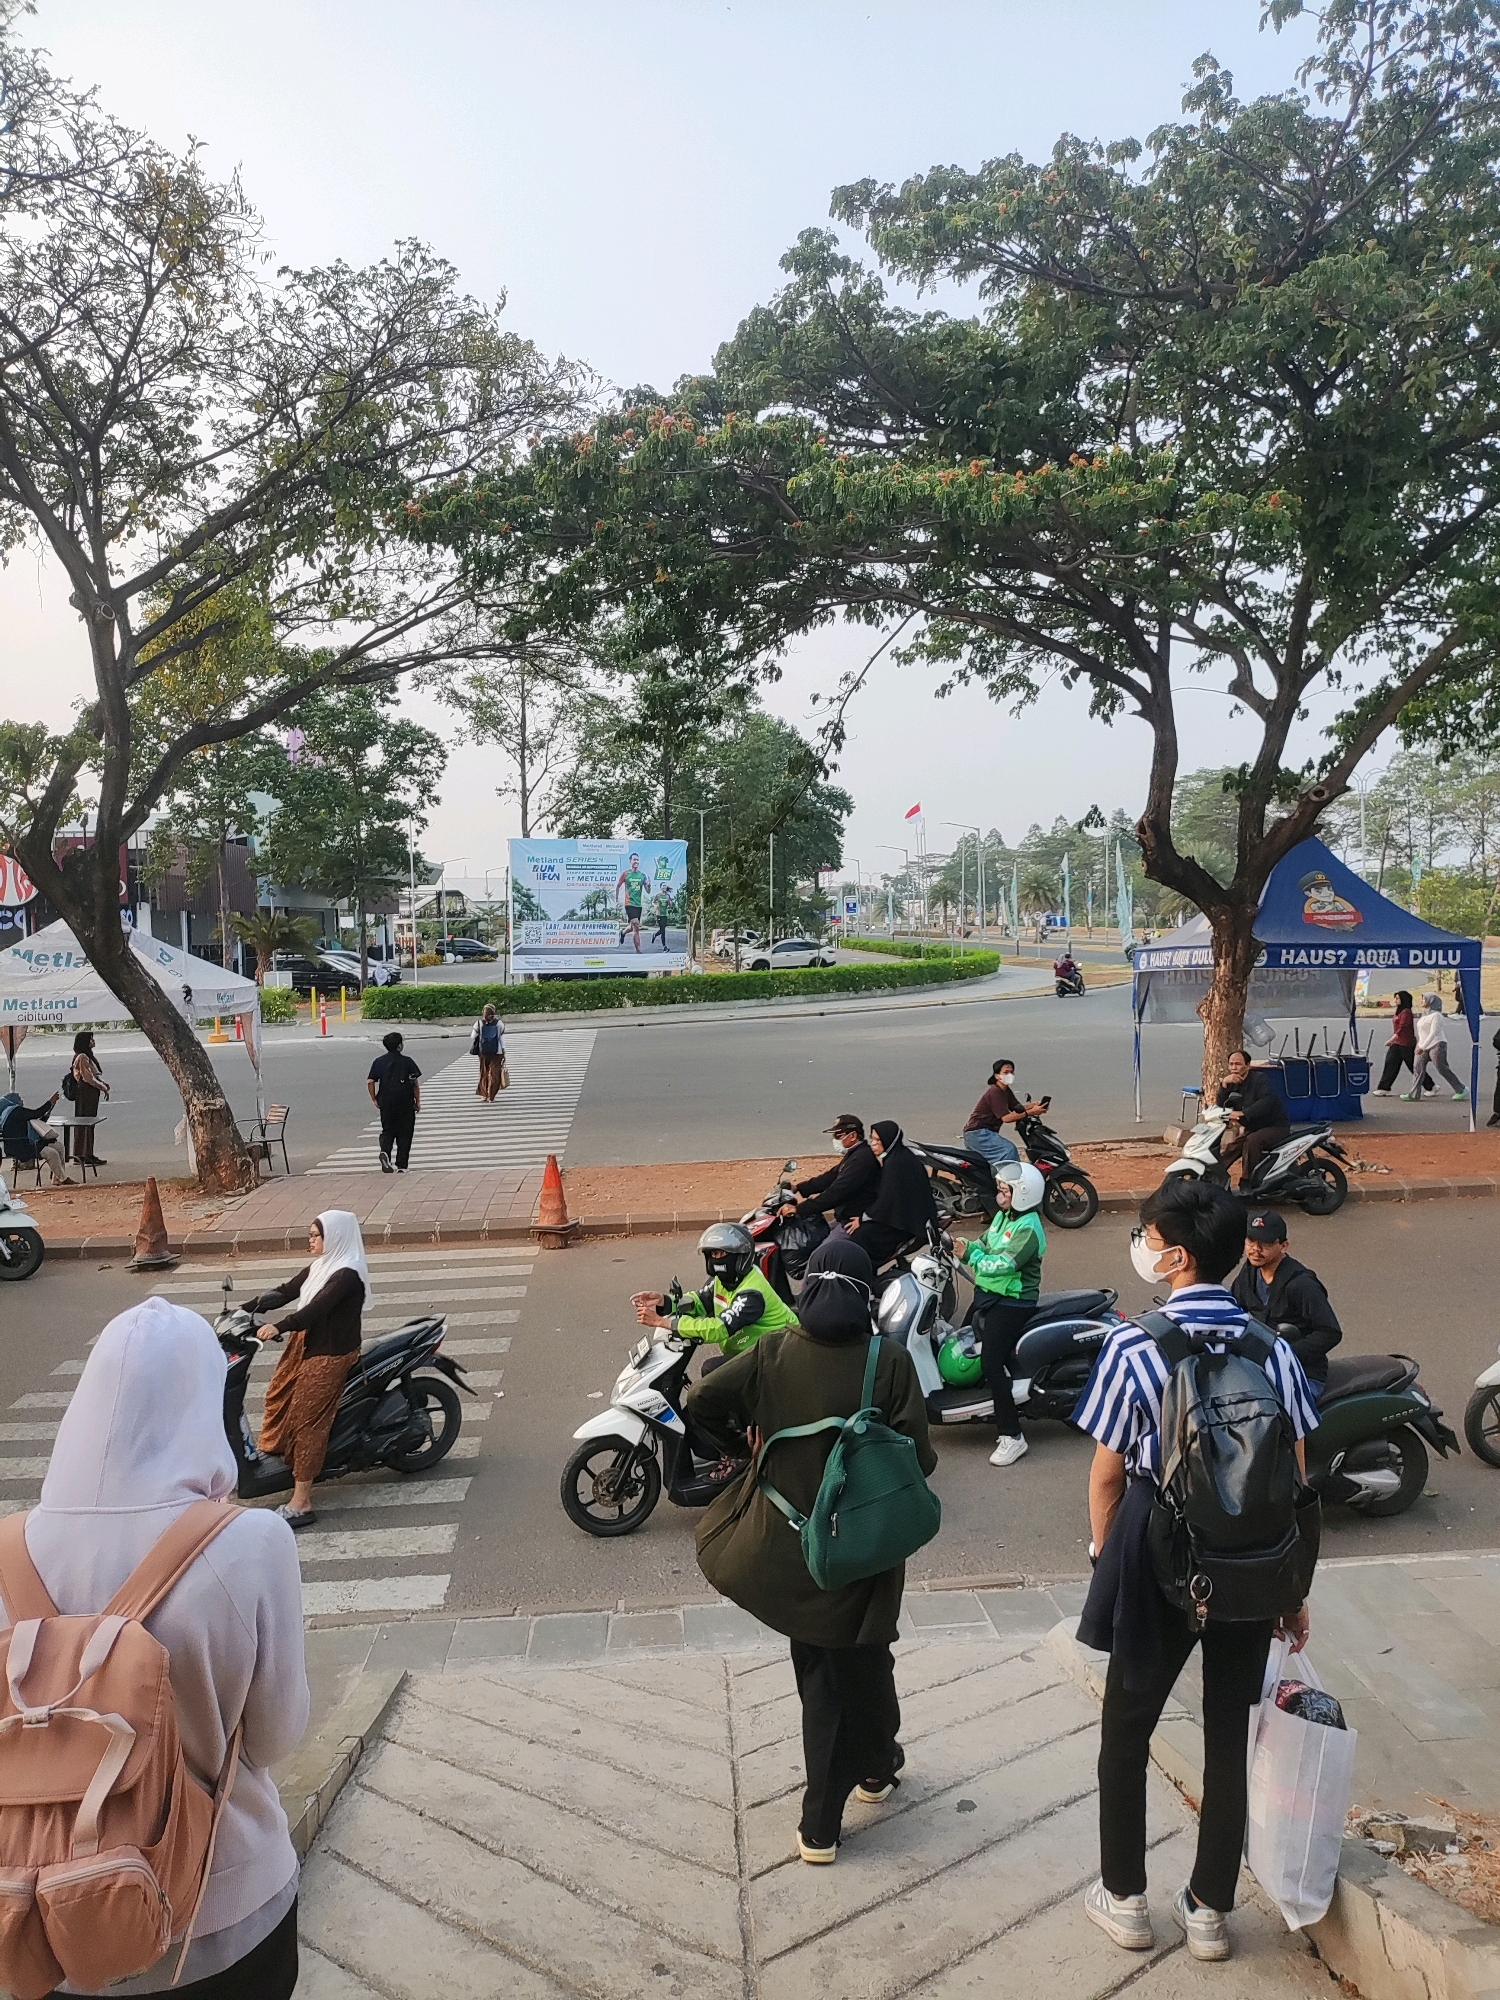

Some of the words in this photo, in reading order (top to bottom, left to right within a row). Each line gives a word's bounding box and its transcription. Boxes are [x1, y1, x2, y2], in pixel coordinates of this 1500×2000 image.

[1150, 953, 1172, 967] HAUS?
[1280, 949, 1346, 965] HAUS?
[1354, 949, 1401, 968] AQUA
[1408, 950, 1461, 965] DULU
[3, 997, 78, 1010] Metland
[17, 1012, 63, 1022] cibitung
[637, 1396, 659, 1406] HONDA
